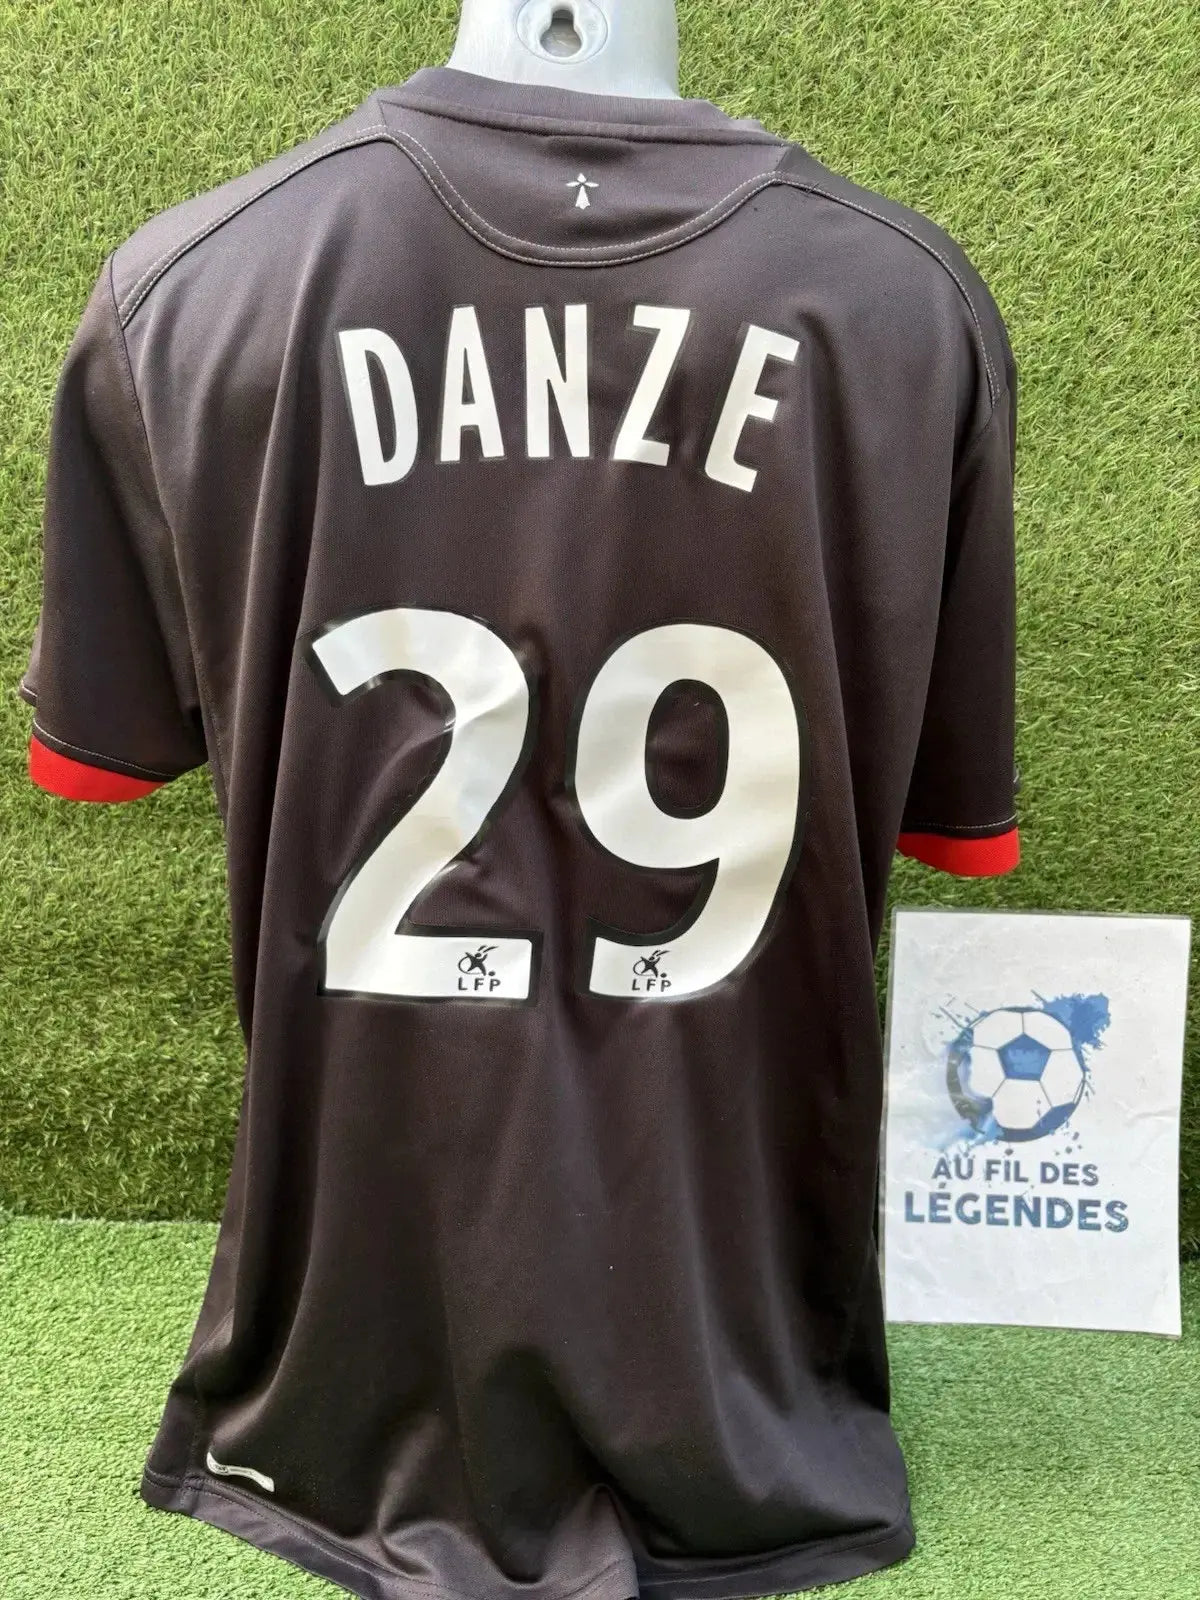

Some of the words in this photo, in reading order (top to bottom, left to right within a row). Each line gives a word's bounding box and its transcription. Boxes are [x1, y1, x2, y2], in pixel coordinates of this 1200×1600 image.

[338, 303, 800, 493] DANZE
[311, 607, 800, 999] 29
[458, 976, 501, 992] LFP
[632, 978, 672, 992] LFP
[932, 1157, 974, 1181] AU
[984, 1159, 1029, 1183] FIL
[1040, 1161, 1099, 1187] DES
[904, 1182, 1130, 1233] LÉGENDES
